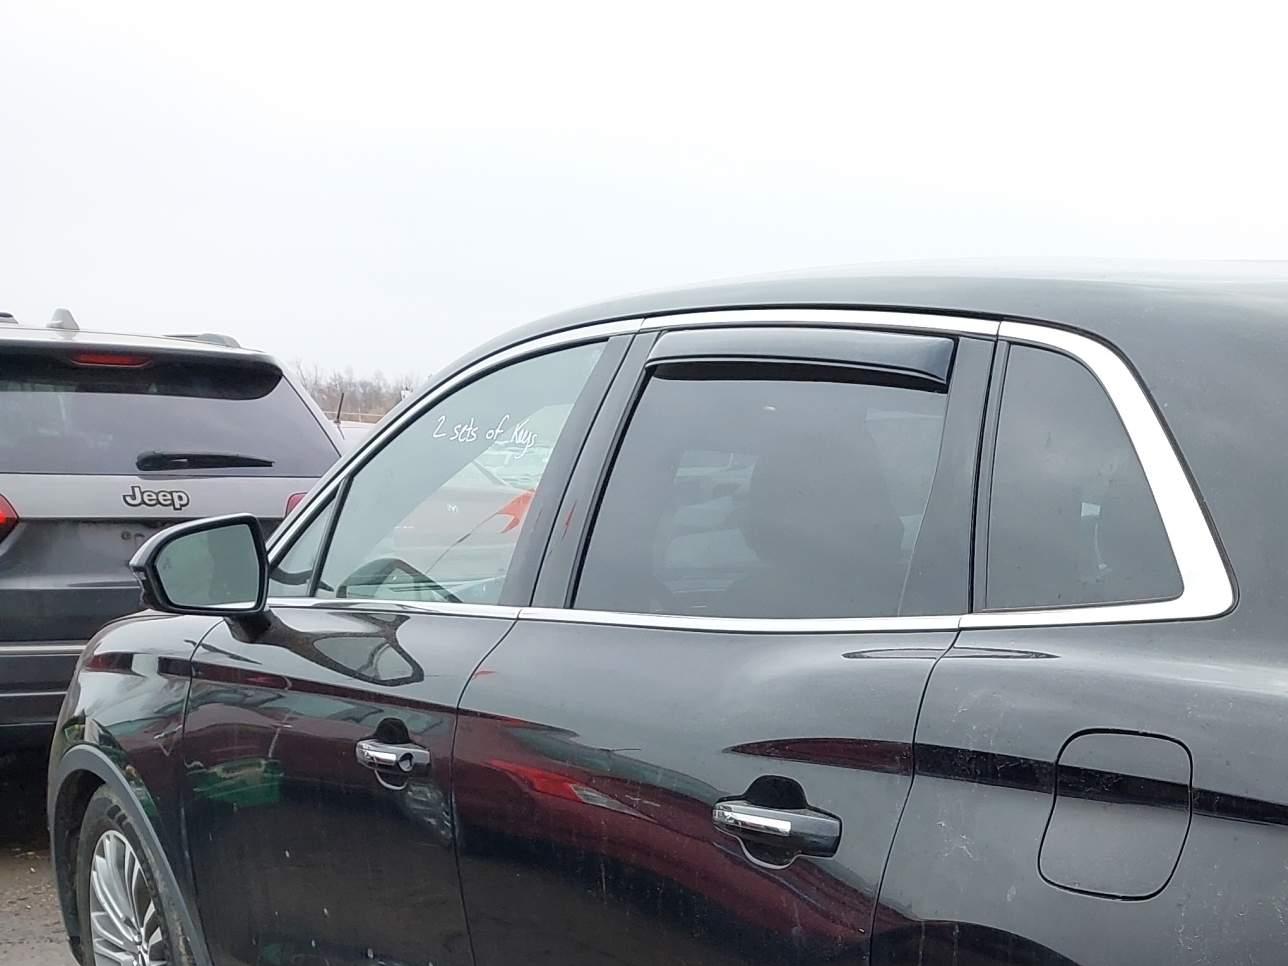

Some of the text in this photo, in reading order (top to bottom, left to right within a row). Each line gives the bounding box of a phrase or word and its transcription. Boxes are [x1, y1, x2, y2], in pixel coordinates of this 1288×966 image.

[433, 416, 446, 437] 2
[450, 418, 478, 442] sets
[486, 414, 510, 440] of
[123, 485, 190, 511] Jeep
